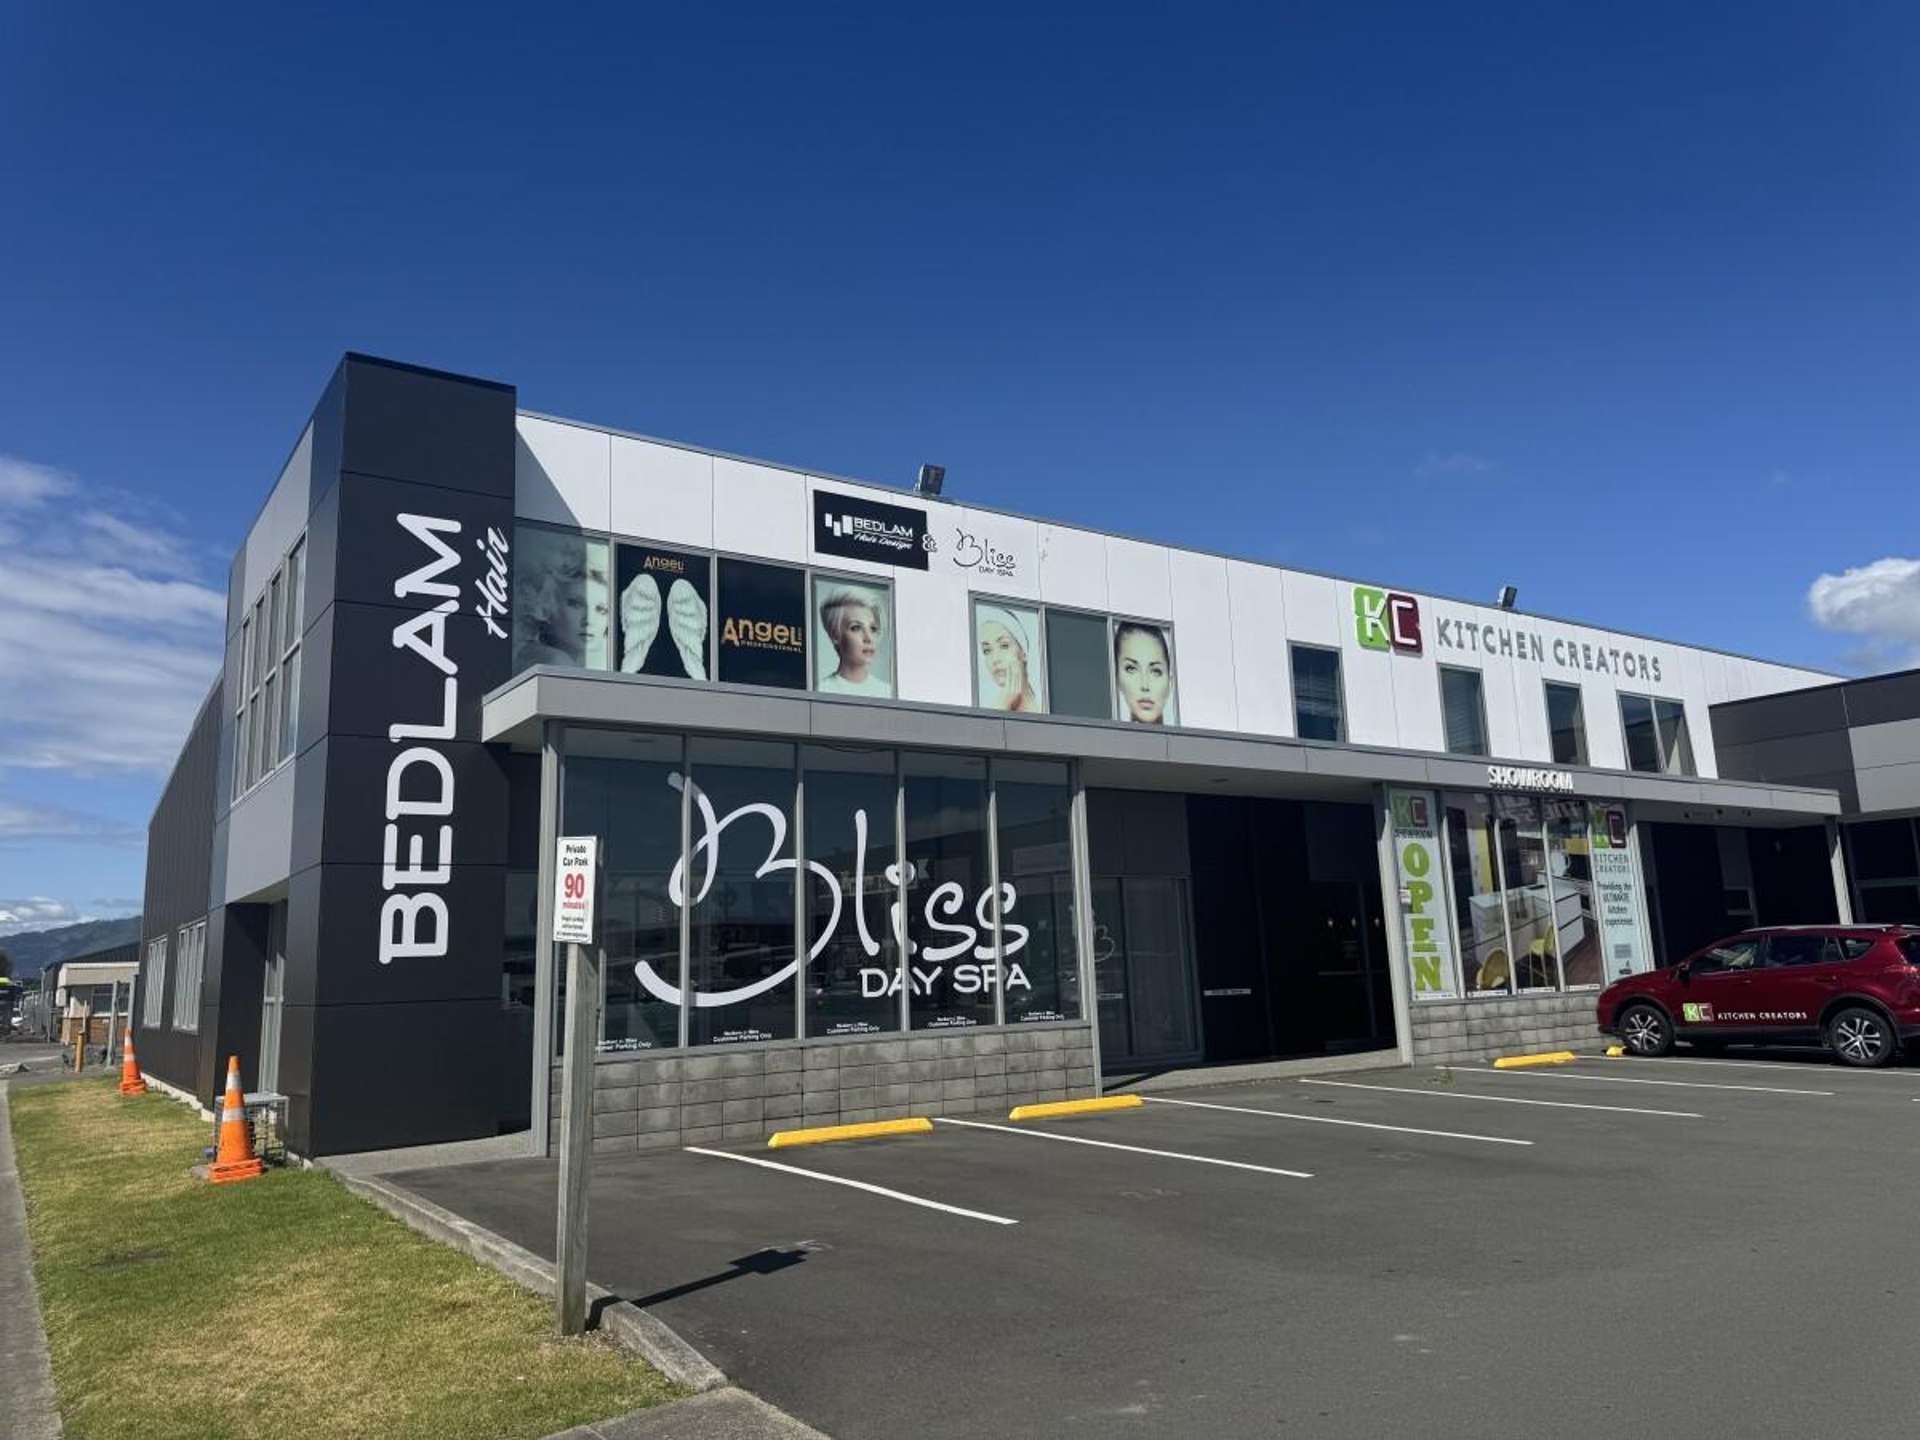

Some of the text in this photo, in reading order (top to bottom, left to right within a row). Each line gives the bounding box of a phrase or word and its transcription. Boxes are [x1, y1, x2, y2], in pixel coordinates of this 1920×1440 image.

[853, 516, 913, 538] BEDLAM
[922, 533, 938, 553] &
[953, 528, 1016, 569] Bliss
[475, 526, 510, 640] Hair
[1360, 592, 1420, 648] KC
[1436, 616, 1662, 682] KITCHEN CREATORS
[378, 512, 462, 964] BEDLAM
[1487, 765, 1574, 790] SHOWROOM
[562, 857, 589, 867] Car Park
[565, 844, 587, 854] Private
[564, 873, 585, 899] 90
[634, 771, 1030, 1008] Bliss
[1403, 842, 1442, 992] OPEN
[859, 964, 1031, 998] DAY SPA
[1683, 1003, 1714, 1021] KC
[1718, 1011, 1808, 1020] KITCHEN CREATORS
